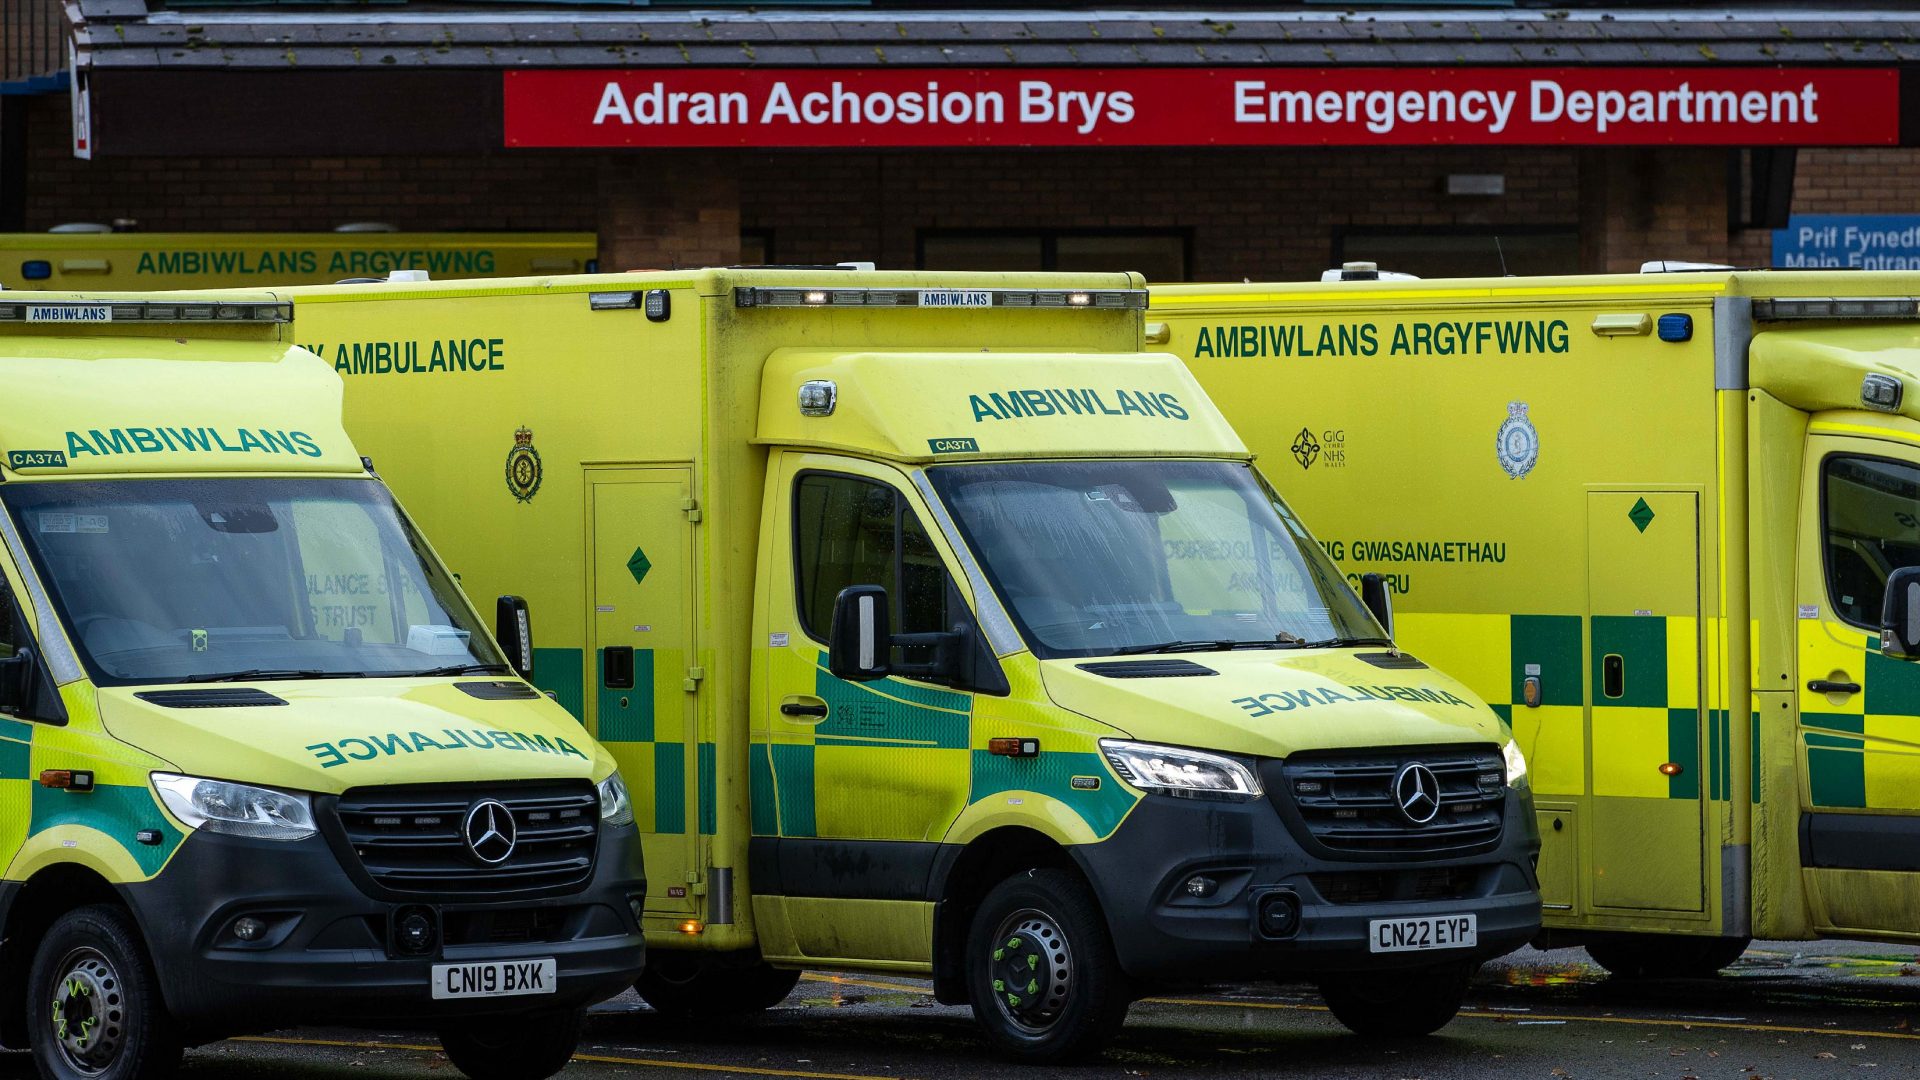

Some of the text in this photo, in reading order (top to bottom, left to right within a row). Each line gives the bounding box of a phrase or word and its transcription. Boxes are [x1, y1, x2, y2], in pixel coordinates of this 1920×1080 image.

[593, 81, 1135, 134] Adran Achosion Brys
[1234, 80, 1818, 133] Emergency Department
[1799, 226, 1838, 248] Prif
[137, 250, 495, 274] AMBIWLANS ARGYFWNG
[1784, 252, 1840, 267] Main
[923, 293, 988, 306] AMBIWLANS
[32, 306, 107, 321] AMBIWLANS
[1194, 320, 1569, 358] AMBIWLANS ARGYFWNG
[335, 339, 504, 375] AMBULANCE
[969, 389, 1189, 423] AMBIWLANS
[65, 427, 322, 459] AMBIWLANS
[936, 441, 972, 451] CA371
[1323, 430, 1345, 442] GIG
[12, 453, 63, 465] CA374
[1323, 450, 1345, 461] NHS
[1351, 540, 1506, 563] GWASANAETHAU
[1380, 918, 1469, 948] CN22 EYP
[447, 963, 543, 993] CN19 BXK
